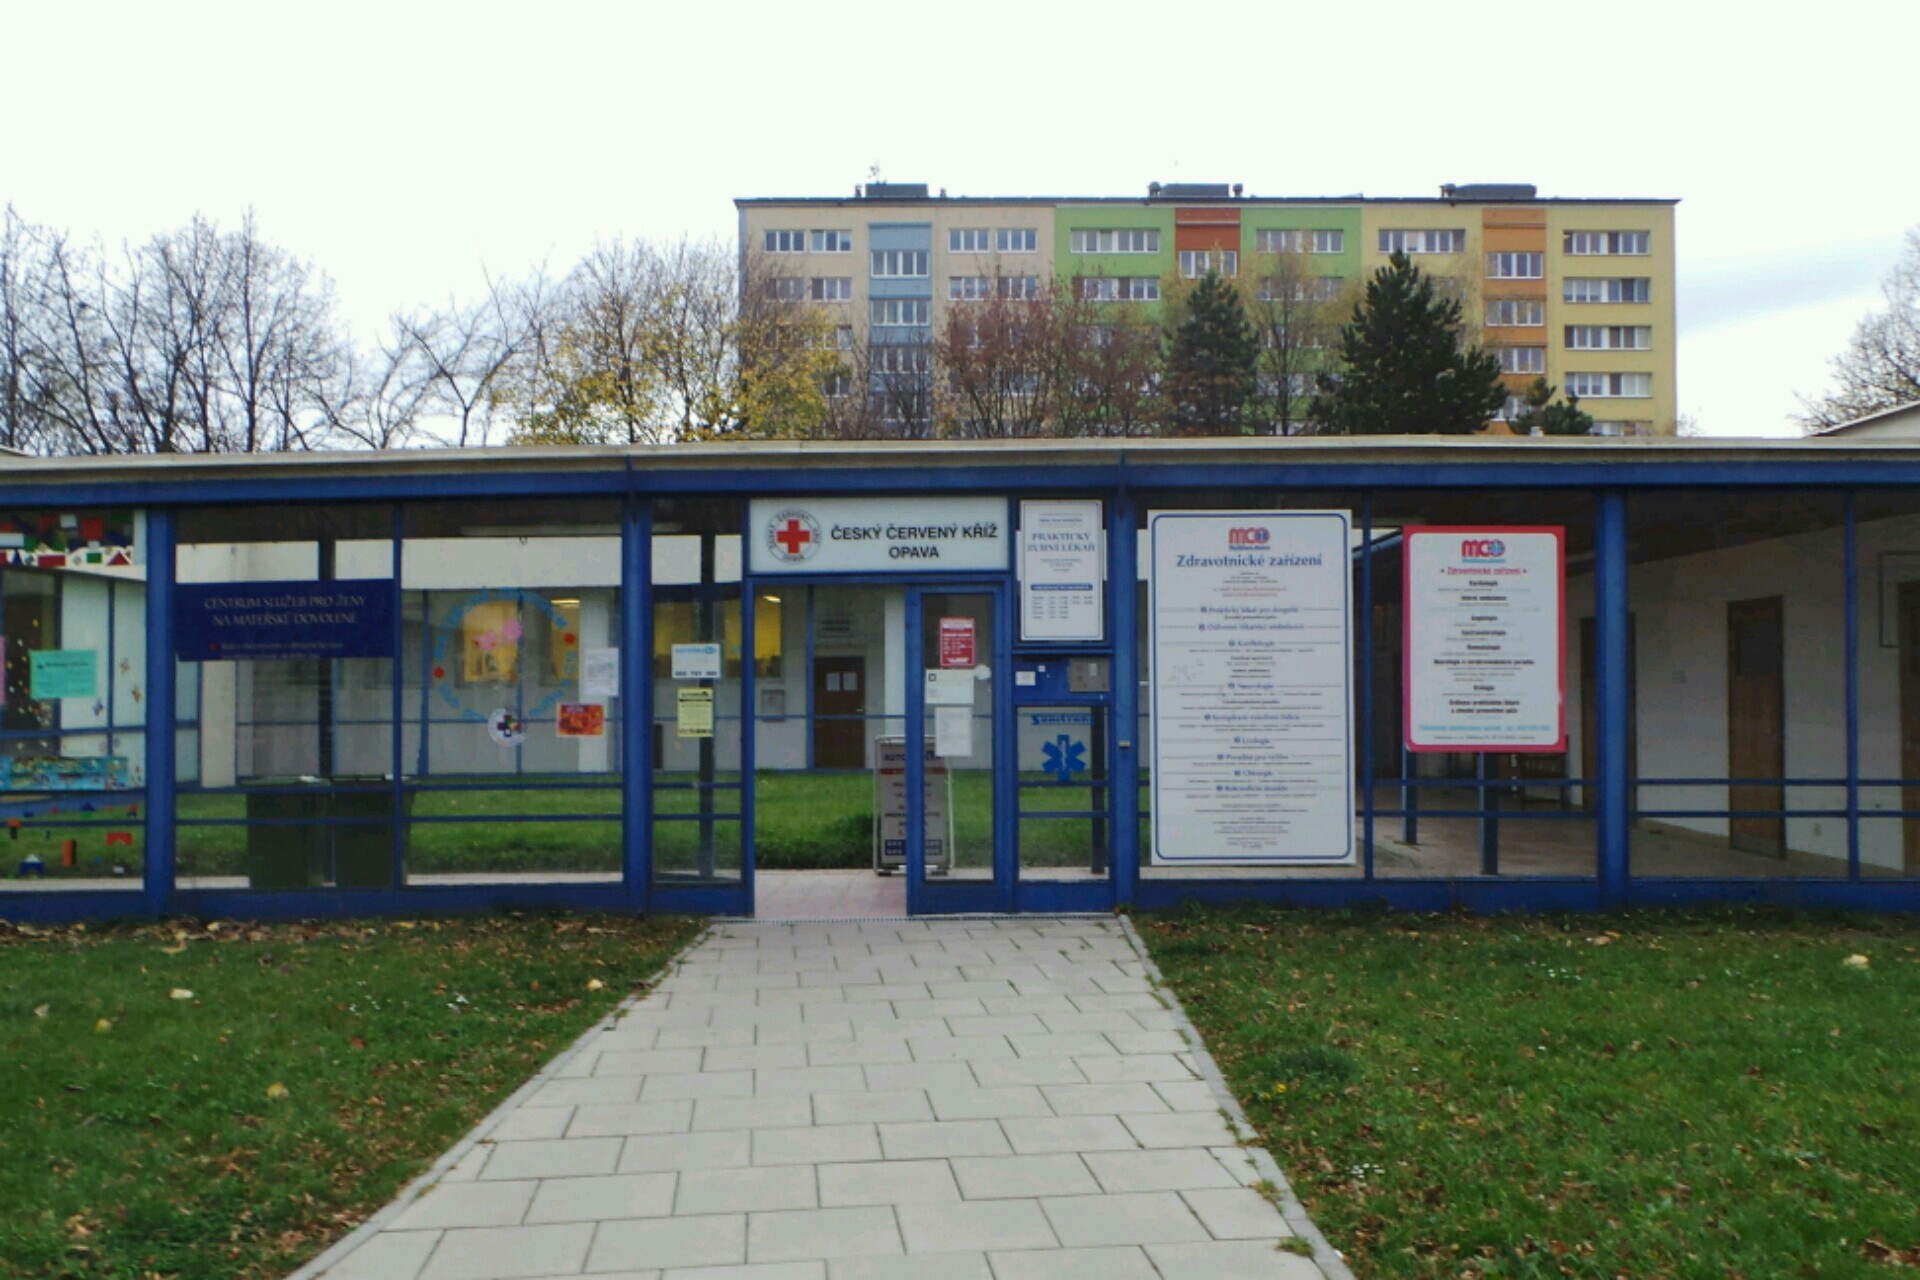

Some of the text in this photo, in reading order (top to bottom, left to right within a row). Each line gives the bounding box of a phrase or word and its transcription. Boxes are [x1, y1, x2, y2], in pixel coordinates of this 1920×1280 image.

[830, 521, 998, 540] ČESKÝ ČERVENÝ KŘÍŽ
[888, 546, 940, 559] OPAVA
[1176, 553, 1323, 567] Zdravotnické zařízení
[204, 593, 365, 609] CENTRUM SLUŽEB PRO ŽENY
[213, 611, 357, 625] NA MATEŘSKÉ DOVOLENÉ
